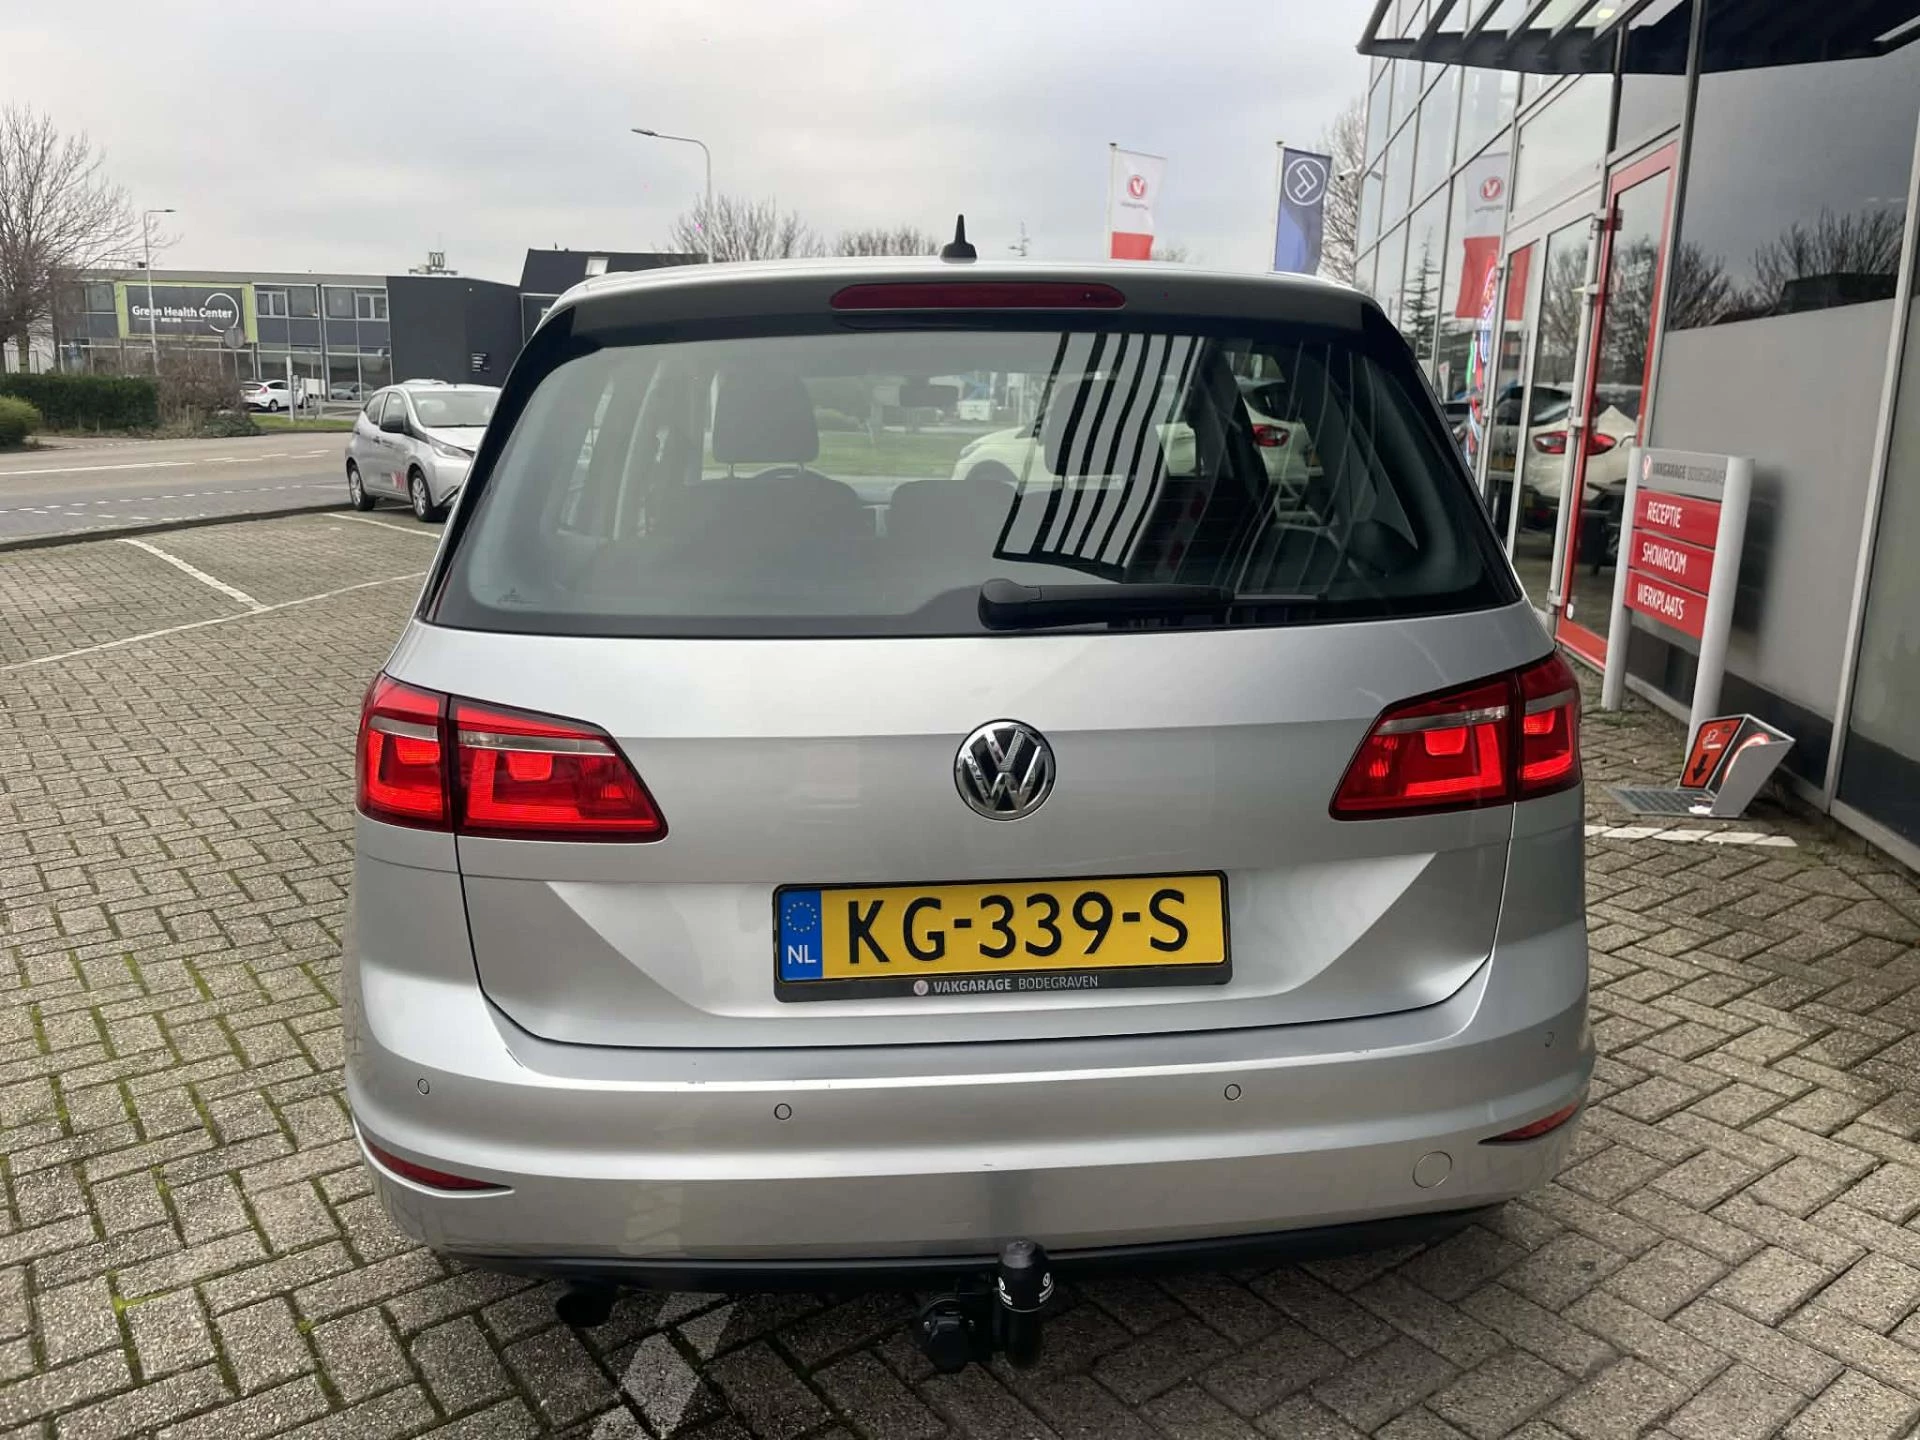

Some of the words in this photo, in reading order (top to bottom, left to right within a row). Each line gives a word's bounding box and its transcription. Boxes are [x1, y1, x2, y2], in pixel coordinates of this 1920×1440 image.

[163, 306, 197, 317] Health
[199, 307, 232, 319] Center
[1646, 501, 1682, 528] RECEPTIE
[1642, 542, 1687, 575] SHOWROOM
[1637, 583, 1684, 620] WERKPLAATS
[847, 888, 1189, 965] KG-339-S
[788, 944, 817, 964] NL
[933, 979, 1012, 993] VAKGARAGE
[1018, 975, 1098, 990] BODEGRAVEN
